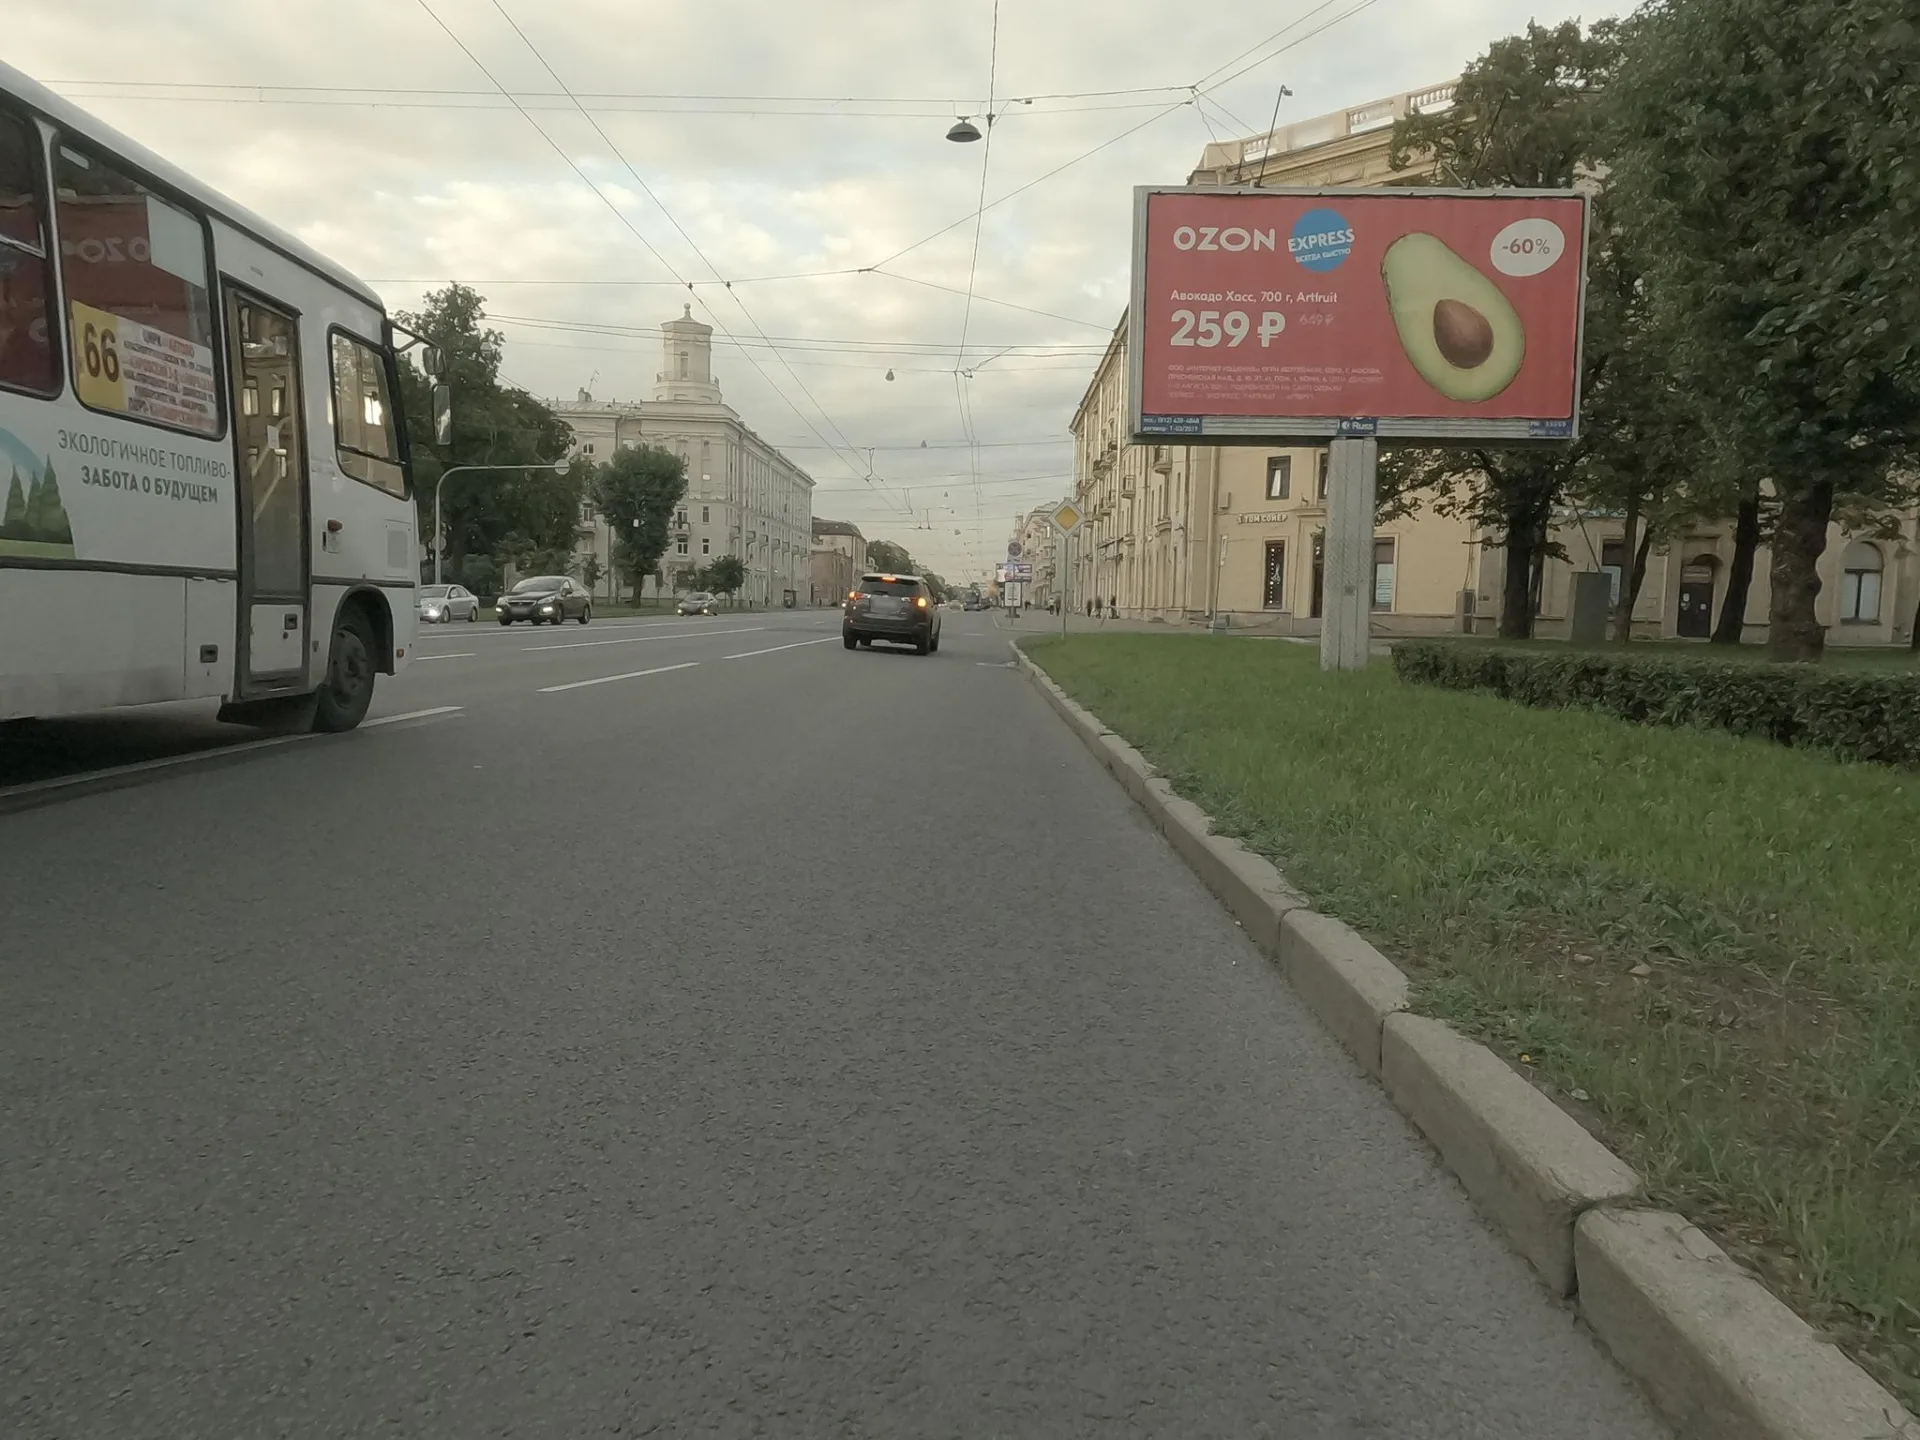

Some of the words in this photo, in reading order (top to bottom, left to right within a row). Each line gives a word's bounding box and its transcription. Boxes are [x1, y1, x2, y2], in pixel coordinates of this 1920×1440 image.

[1173, 226, 1276, 251] OZON
[1287, 228, 1355, 252] EXPRESS
[1502, 238, 1550, 255] -60%
[1170, 289, 1223, 303] Авокадо
[1225, 290, 1257, 303] Хасс,
[1260, 291, 1282, 303] 700
[1296, 291, 1338, 303] Artfruit
[1170, 309, 1251, 348] 259
[83, 322, 120, 383] 66
[1351, 421, 1374, 430] Russ
[57, 429, 166, 468] ЭКОЛОГИЧНОЕ
[81, 465, 140, 493] ЗАБОТА
[142, 476, 151, 494] О
[154, 477, 219, 504] БУДУЩЕМ
